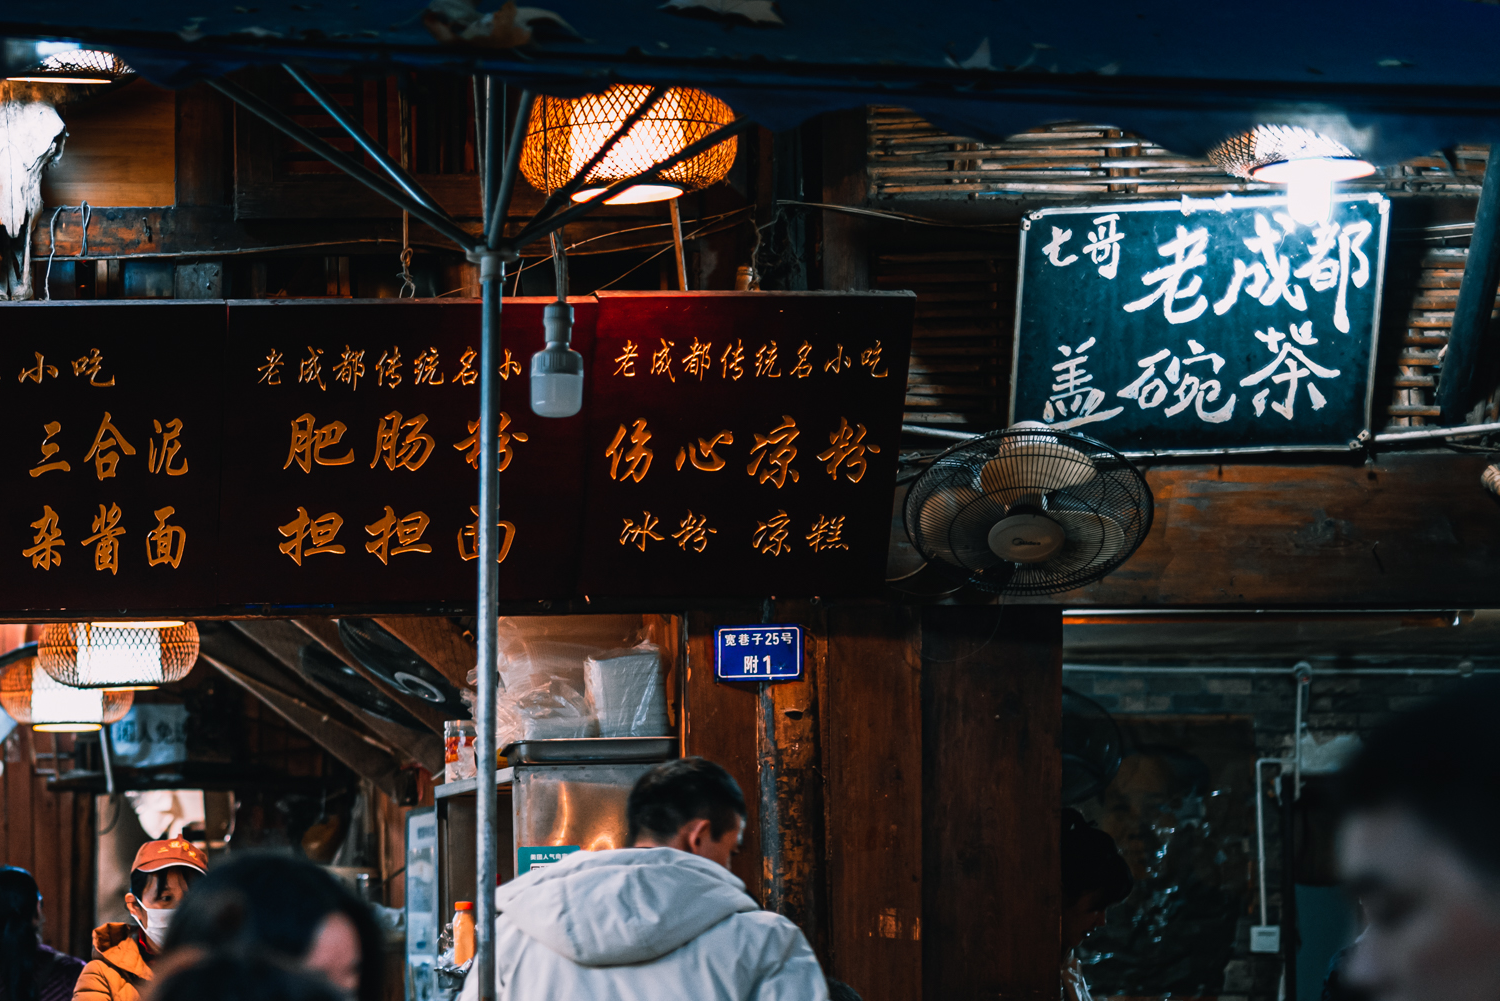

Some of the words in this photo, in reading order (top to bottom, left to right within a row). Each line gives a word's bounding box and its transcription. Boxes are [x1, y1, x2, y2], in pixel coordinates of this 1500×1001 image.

[1042, 213, 1124, 280] 七哥
[1123, 212, 1373, 333] 老成都
[256, 346, 522, 390] 老成都传统名小
[613, 337, 889, 385] 老成都传统名小吃
[1042, 321, 1340, 429] 盖碗茶
[29, 411, 188, 482] 三合泥
[283, 410, 528, 474] 肥肠粉
[605, 415, 881, 489] 伤心凉粉
[22, 502, 186, 575] 杂酱面
[277, 505, 516, 566] 担担面
[620, 509, 717, 552] 冰粉
[753, 509, 849, 557] 凉糕
[724, 632, 793, 646] 宽巷子25号
[743, 655, 771, 674] 附1
